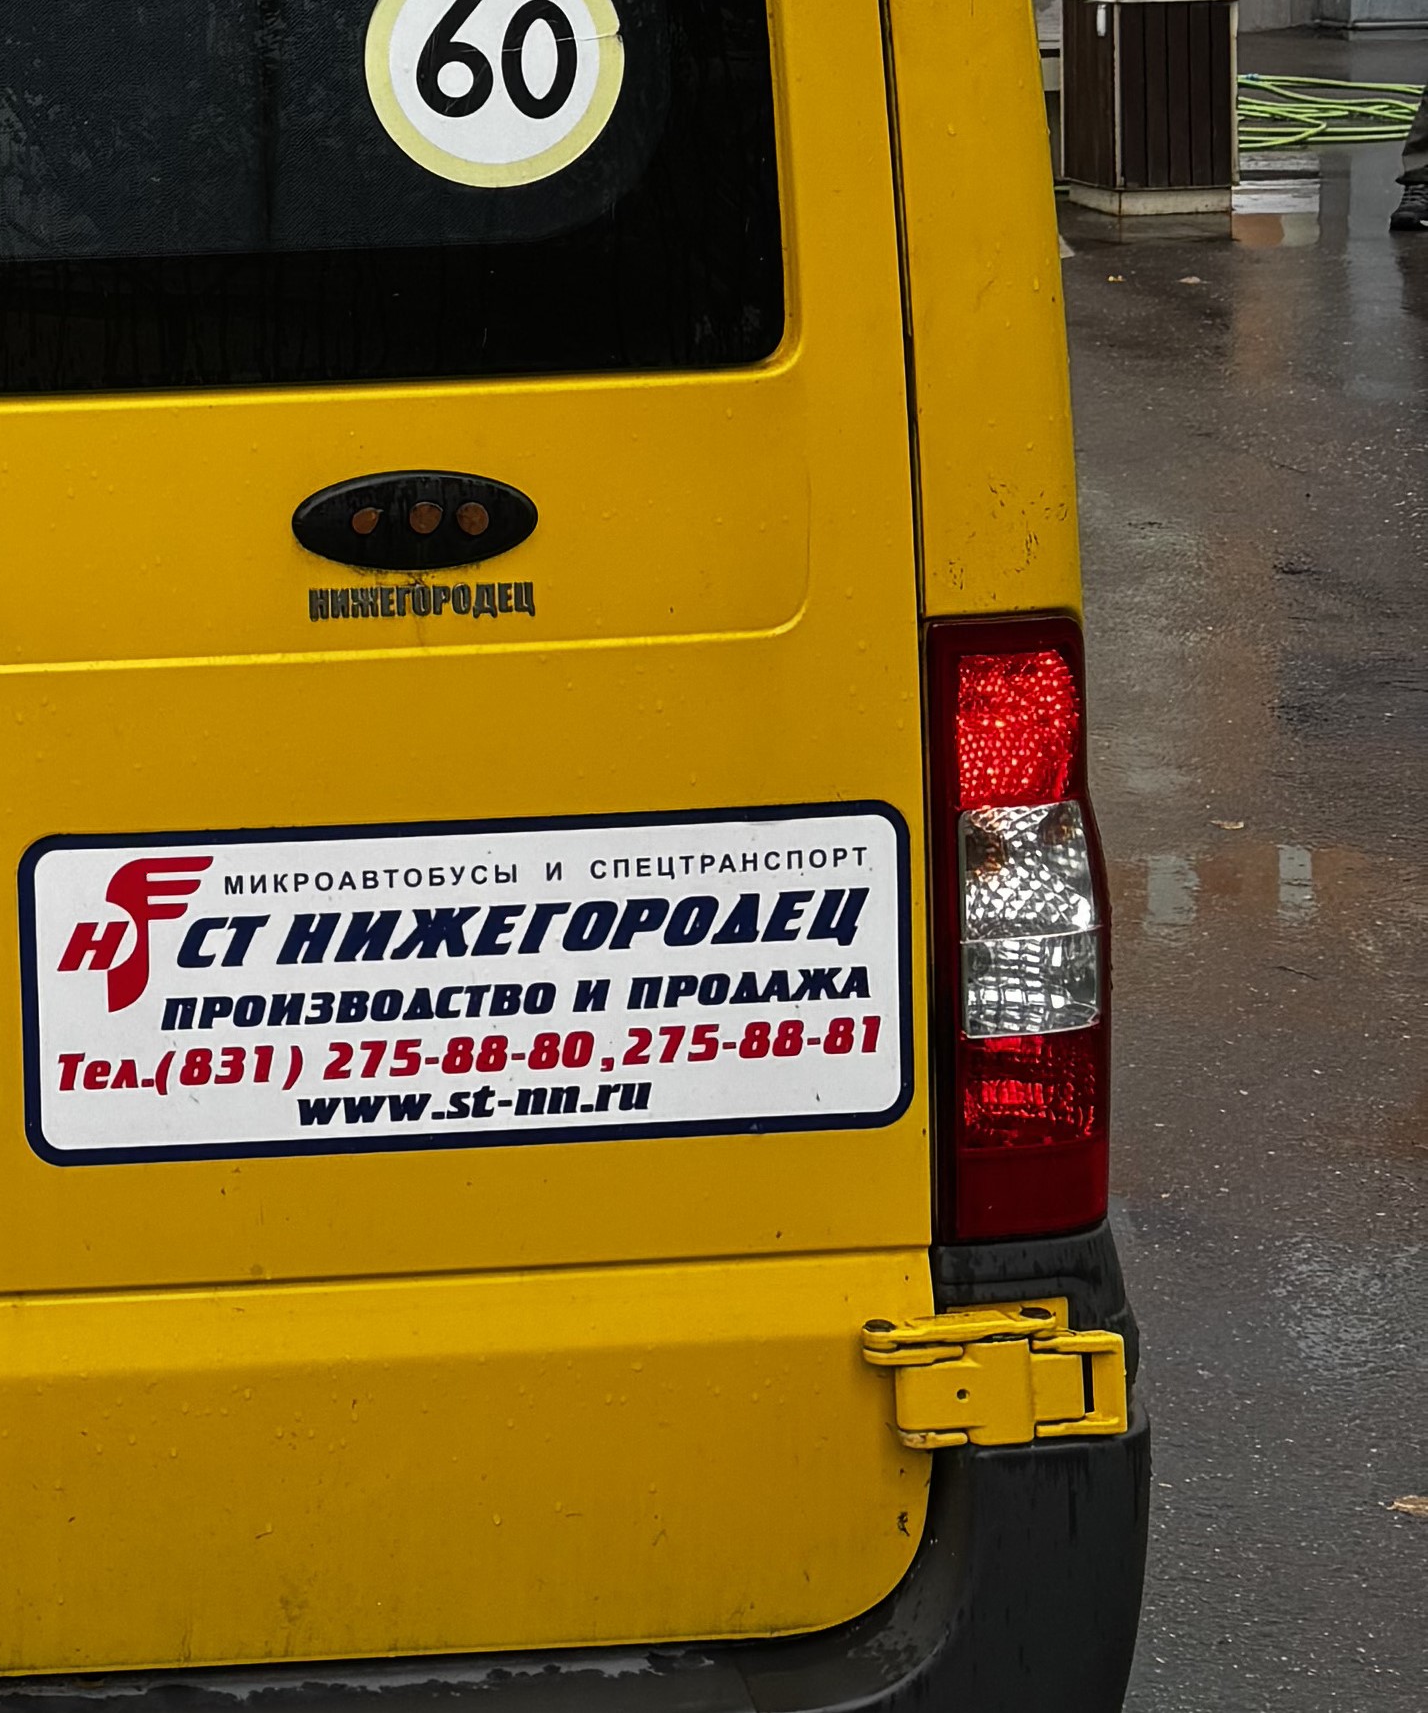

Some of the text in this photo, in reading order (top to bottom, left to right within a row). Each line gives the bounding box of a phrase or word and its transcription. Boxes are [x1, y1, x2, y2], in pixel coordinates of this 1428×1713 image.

[308, 582, 536, 622] НИЖЕГОРОДЕЦ
[223, 846, 868, 896] МИКРОАВТОБУСЫ И СПЕЦТРАНСПОРТ
[176, 887, 870, 969] СТ НИЖЕГОРОДЕЦ
[160, 966, 872, 1031] ПРОИЗВОДСТВО И ПРОДАЖА
[297, 1082, 652, 1127] www.st-nn.ru
